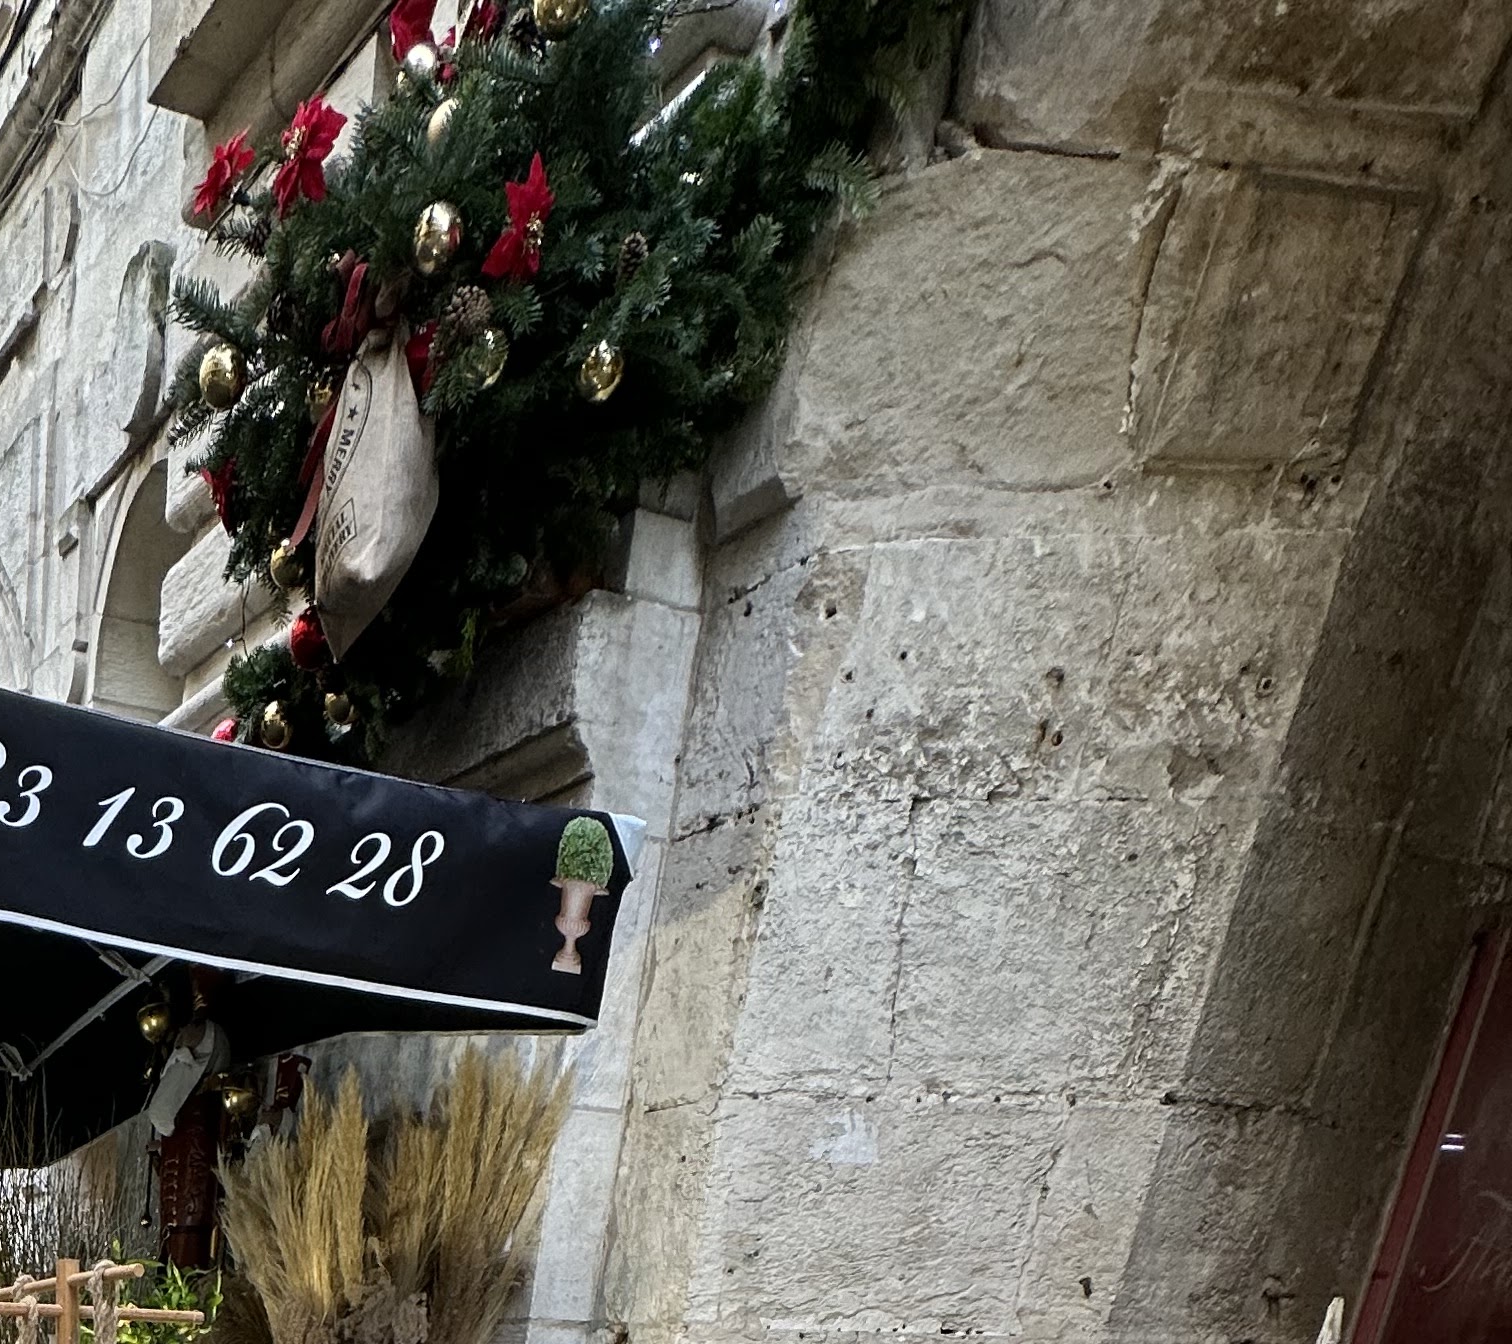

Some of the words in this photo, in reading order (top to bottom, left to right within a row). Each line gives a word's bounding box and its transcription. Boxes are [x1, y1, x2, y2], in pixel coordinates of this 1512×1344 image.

[83, 786, 185, 859] 13
[211, 802, 315, 886] 62
[326, 830, 444, 907] 28
